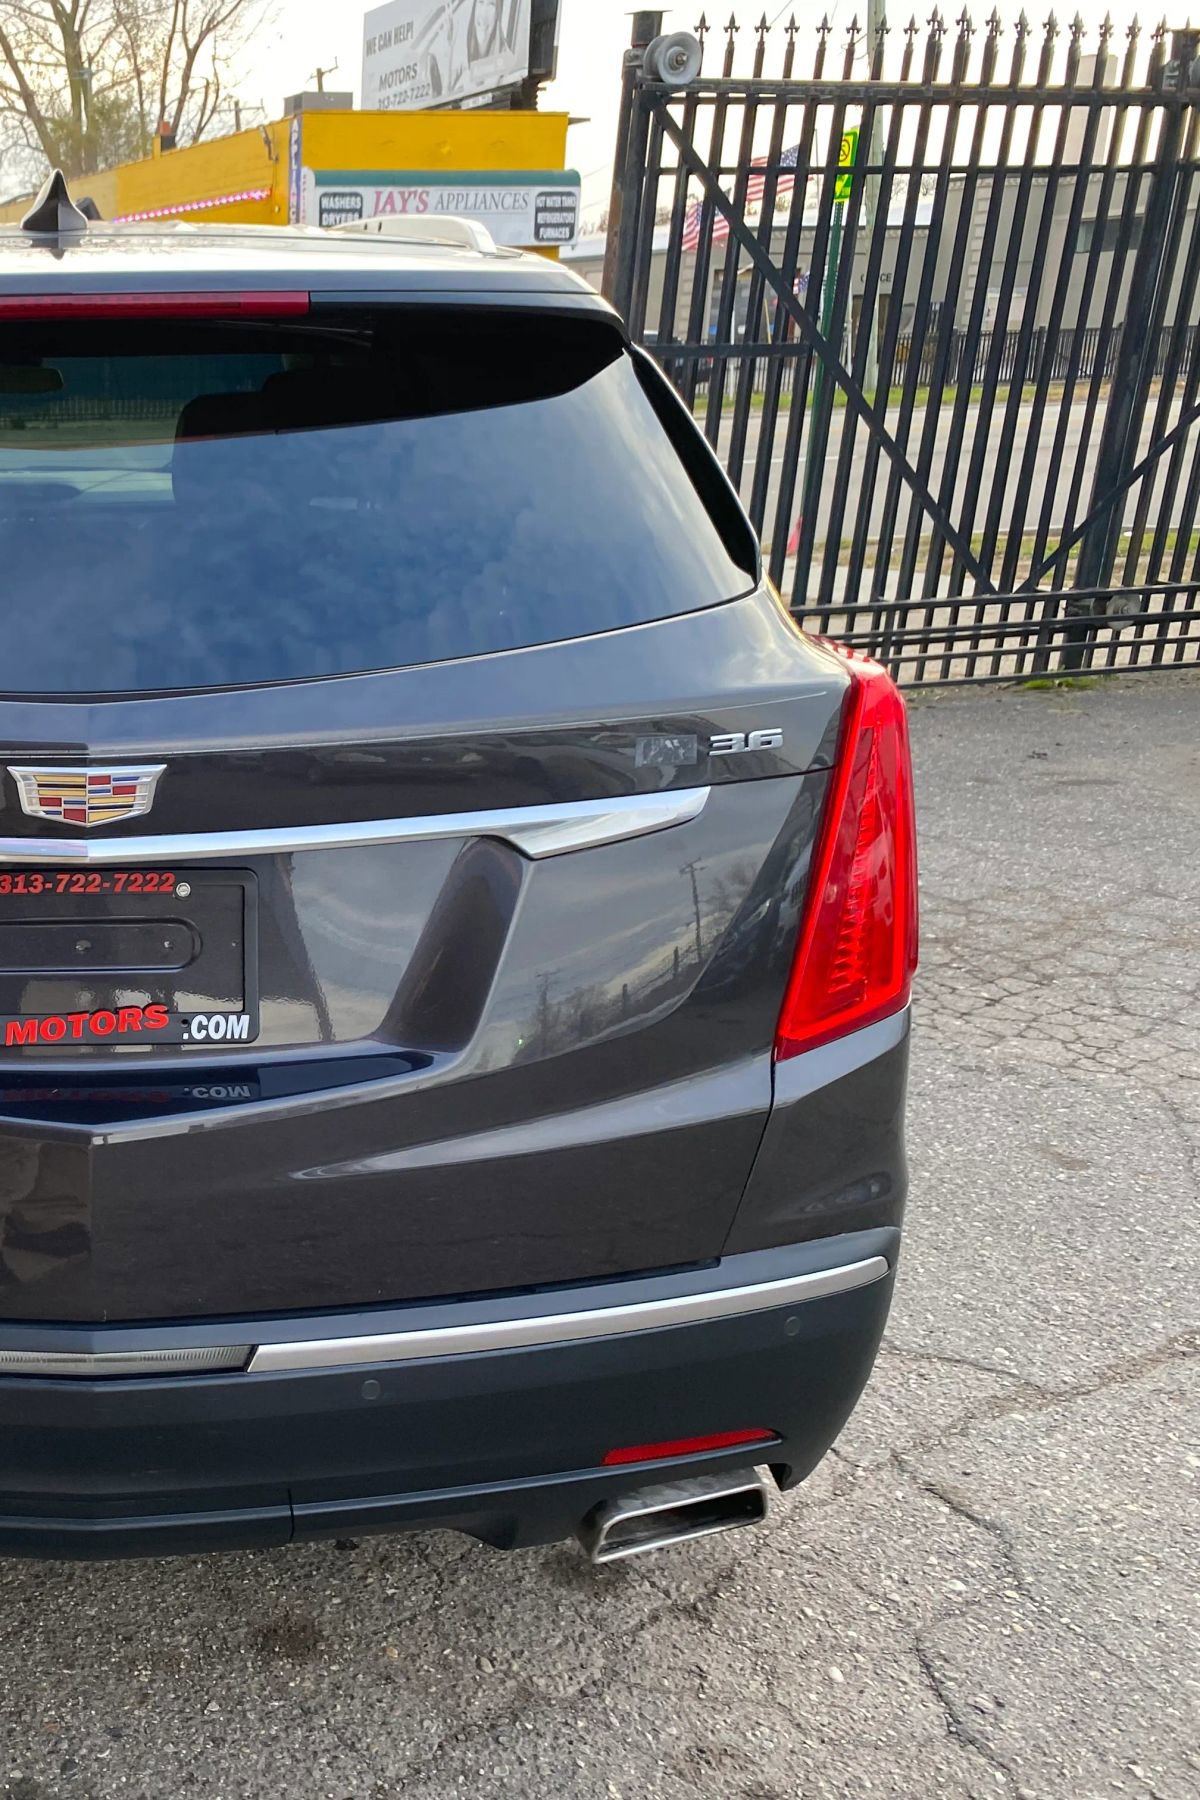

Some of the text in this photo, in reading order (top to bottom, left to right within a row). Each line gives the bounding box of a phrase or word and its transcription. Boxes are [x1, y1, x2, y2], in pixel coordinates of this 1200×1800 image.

[366, 37, 377, 57] WE
[378, 30, 392, 52] CAN
[378, 63, 418, 92] MOTORS
[321, 195, 362, 209] WASHERS
[373, 188, 530, 214] JAY'S APPLIANCES
[4, 1003, 170, 1046] MOTORS
[182, 1014, 250, 1041] .COM
